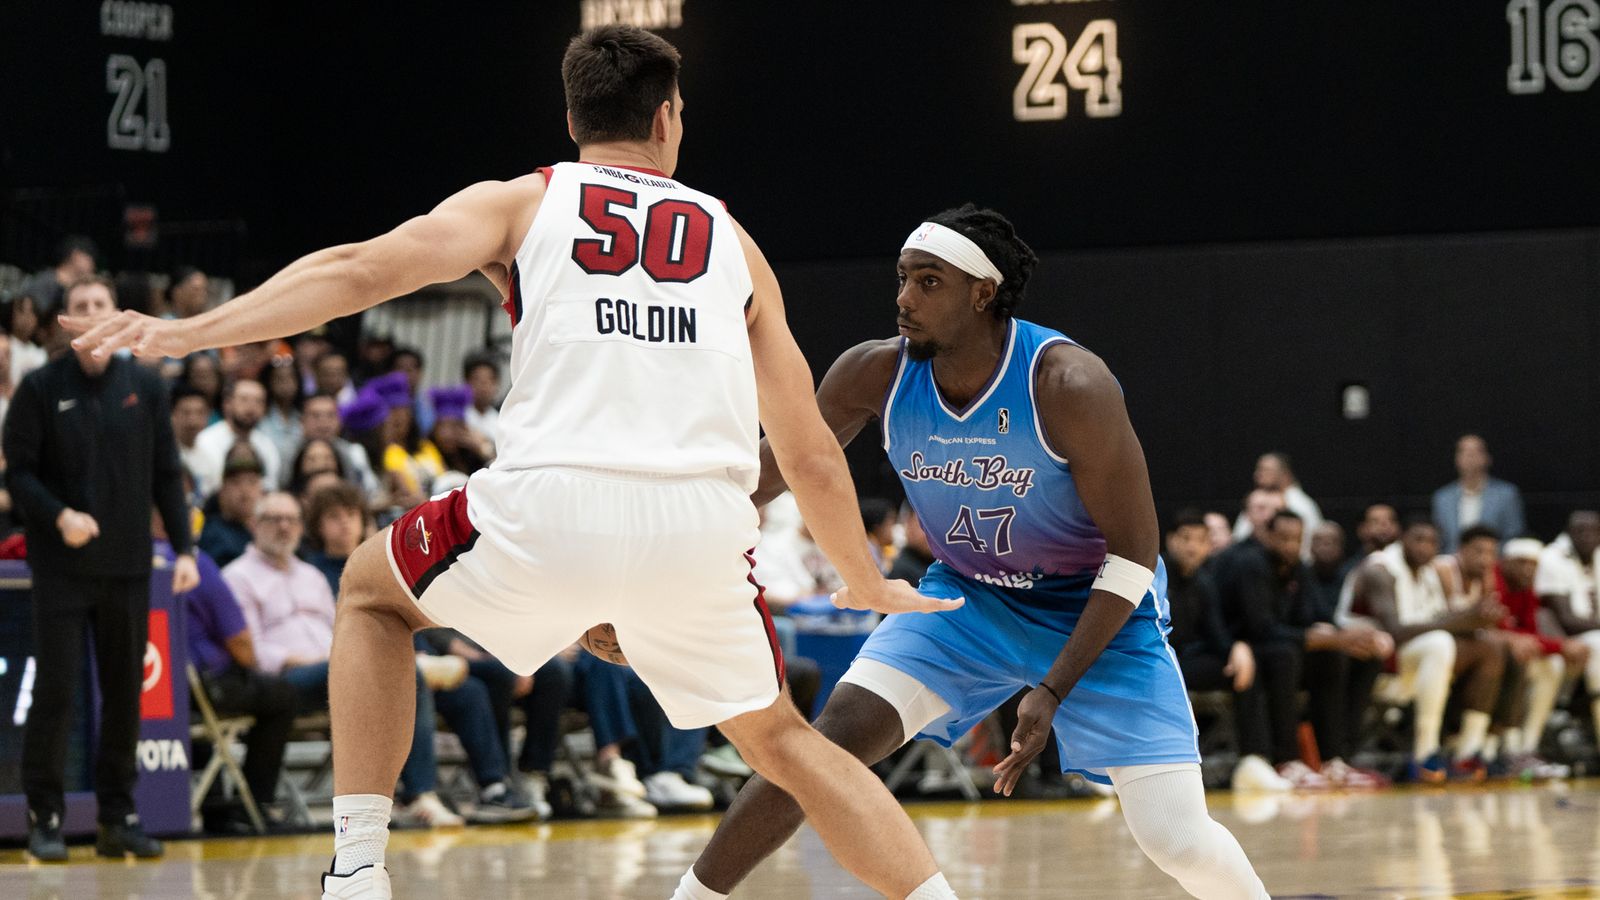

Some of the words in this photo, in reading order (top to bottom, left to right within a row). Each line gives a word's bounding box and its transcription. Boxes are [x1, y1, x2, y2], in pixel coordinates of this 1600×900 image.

[1012, 19, 1122, 121] 24
[1506, 0, 1600, 94] 16
[106, 53, 170, 152] 21
[602, 167, 626, 180] NBA
[571, 183, 714, 284] 50
[595, 297, 697, 343] GOLDIN
[964, 437, 997, 446] EXPRESS
[900, 451, 973, 487] South
[972, 454, 1036, 498] Bay
[945, 504, 1017, 557] 47
